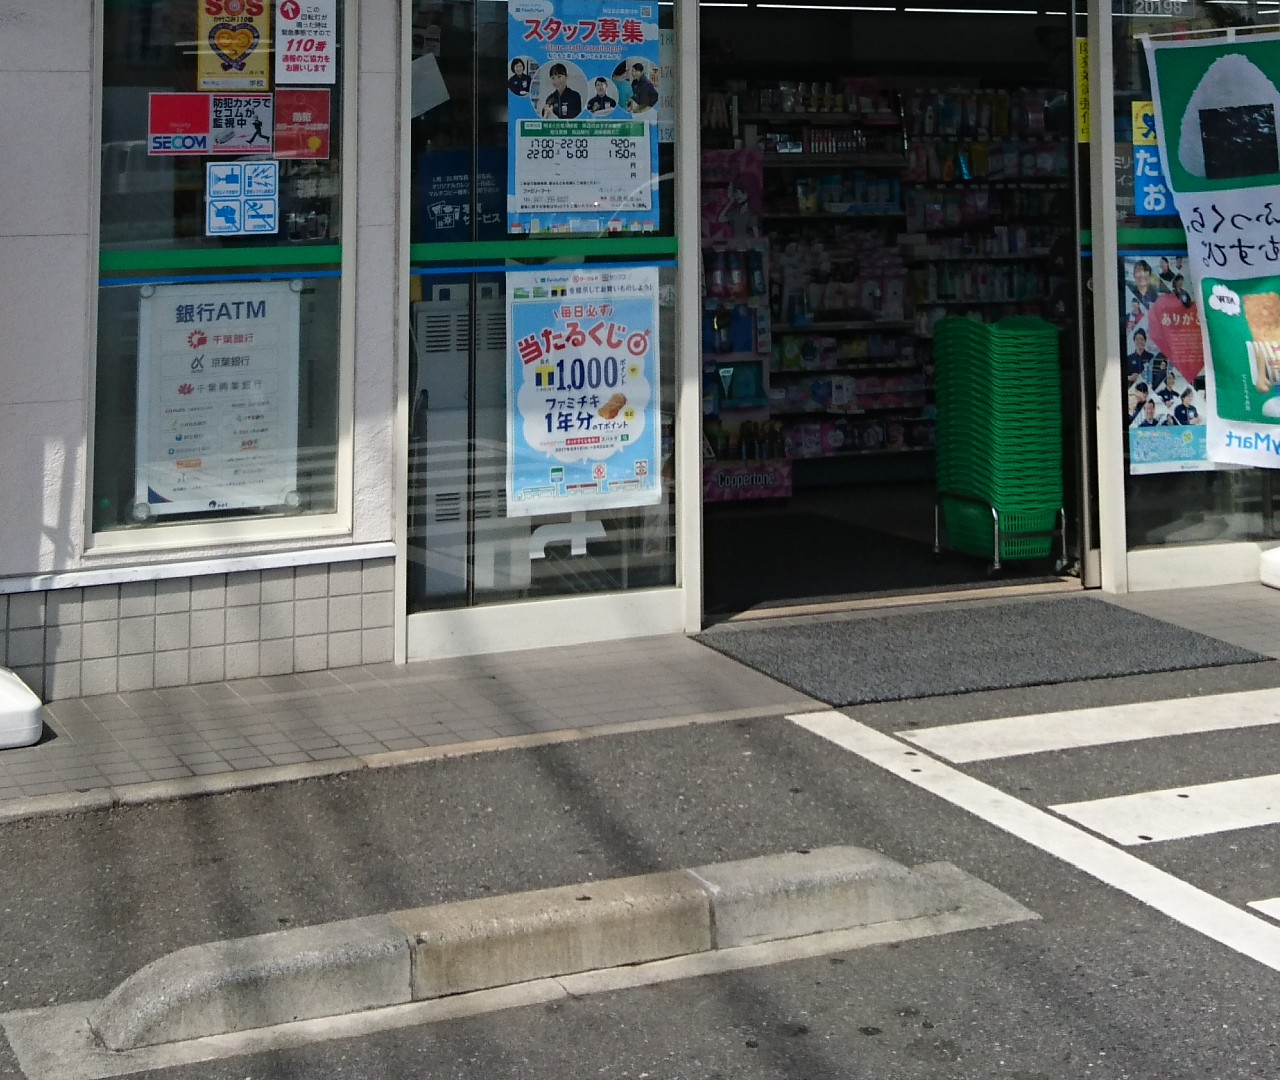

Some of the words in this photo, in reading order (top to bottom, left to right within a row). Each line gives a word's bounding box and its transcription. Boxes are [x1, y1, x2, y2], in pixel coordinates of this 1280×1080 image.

[523, 18, 644, 45] スタッフ募集
[286, 38, 327, 52] 110番
[281, 54, 331, 63] 通報のご協力を
[285, 64, 328, 72] お願いします
[249, 79, 265, 87] 学校
[212, 98, 271, 108] 防犯カメラで
[213, 108, 255, 118] セコムが
[212, 118, 247, 128] 監視中
[153, 135, 207, 150] SECOM
[175, 300, 266, 323] 銀行ATM
[560, 303, 611, 319] 毎日必ず
[212, 333, 254, 345] 千葉銀行
[516, 321, 627, 366] 当たるくじ
[210, 355, 251, 368] 京葉銀行
[556, 356, 618, 391] 1,000
[196, 379, 263, 393] 千葉興業銀行
[545, 394, 600, 411] ファミチキ
[544, 411, 595, 433] 1年分
[717, 471, 776, 489] Coppertone
